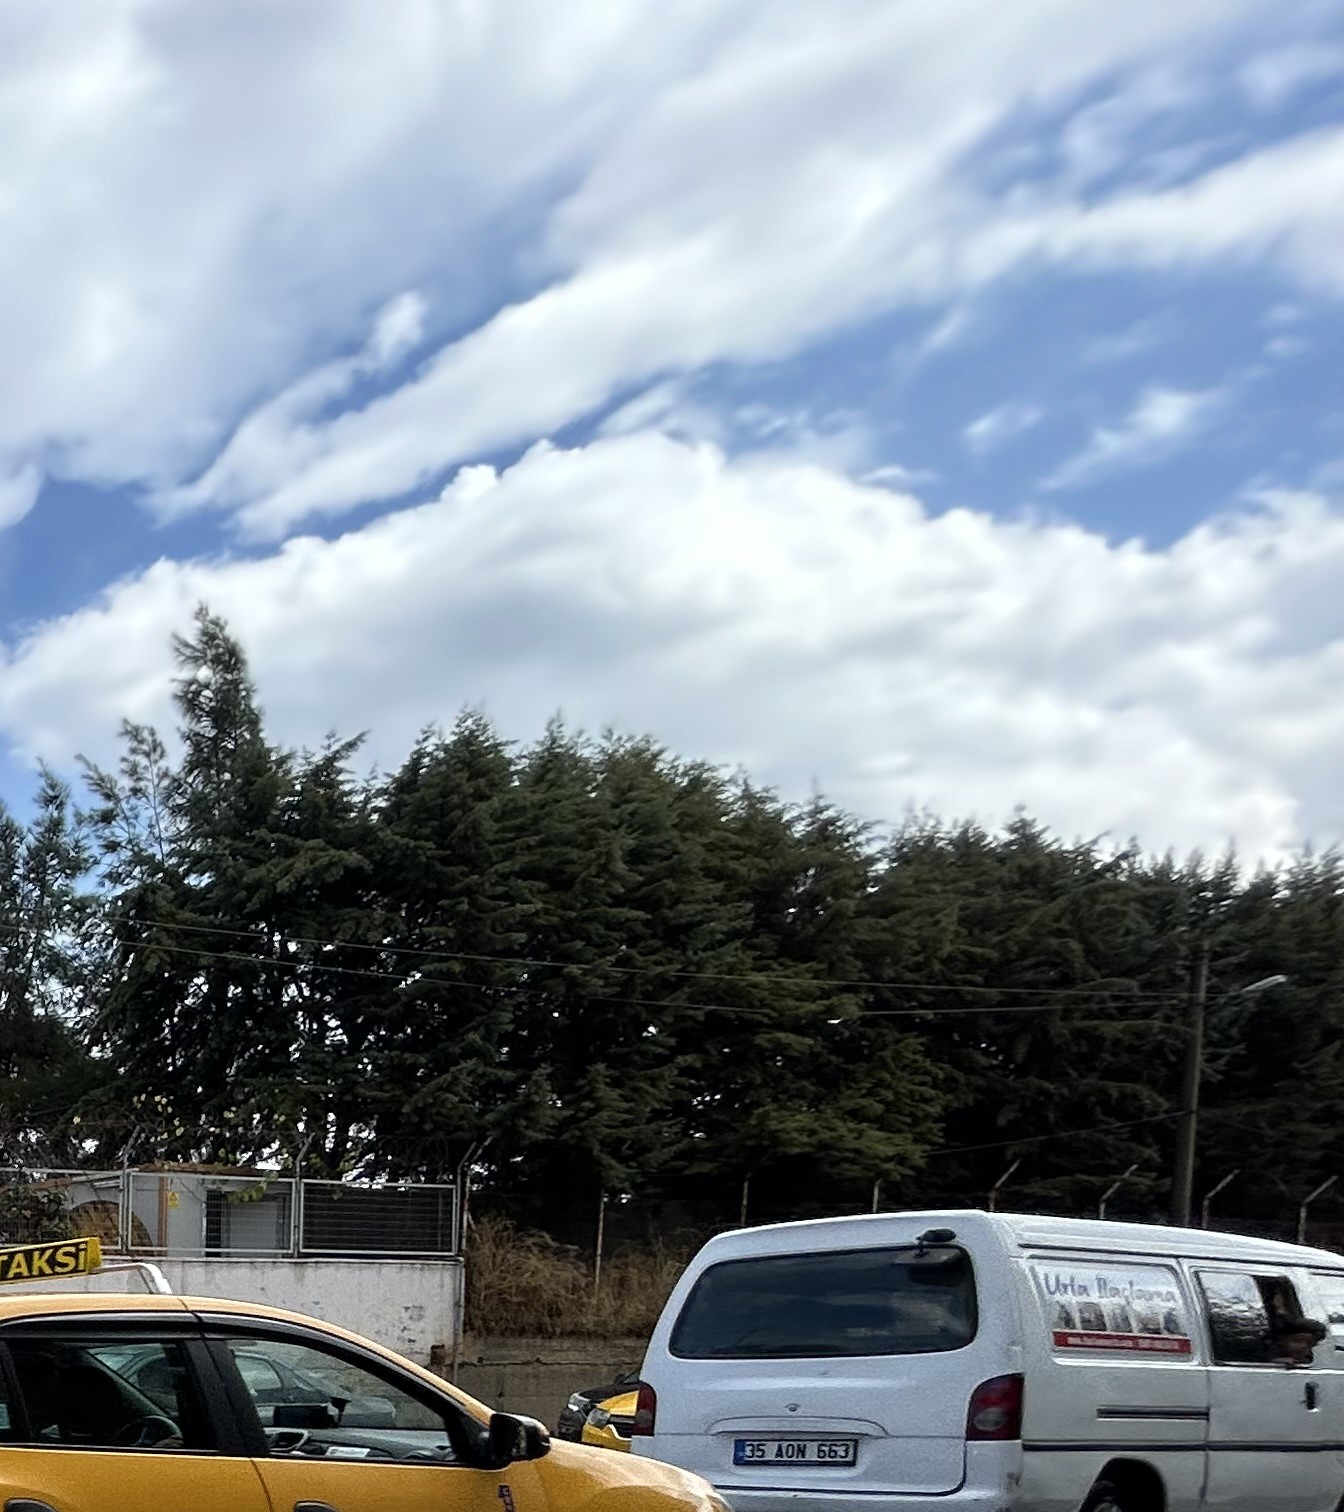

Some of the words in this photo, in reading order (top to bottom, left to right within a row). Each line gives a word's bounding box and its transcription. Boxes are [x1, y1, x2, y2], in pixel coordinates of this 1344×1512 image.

[746, 1443, 766, 1459] 35
[774, 1443, 807, 1459] AON
[817, 1443, 850, 1459] 663
